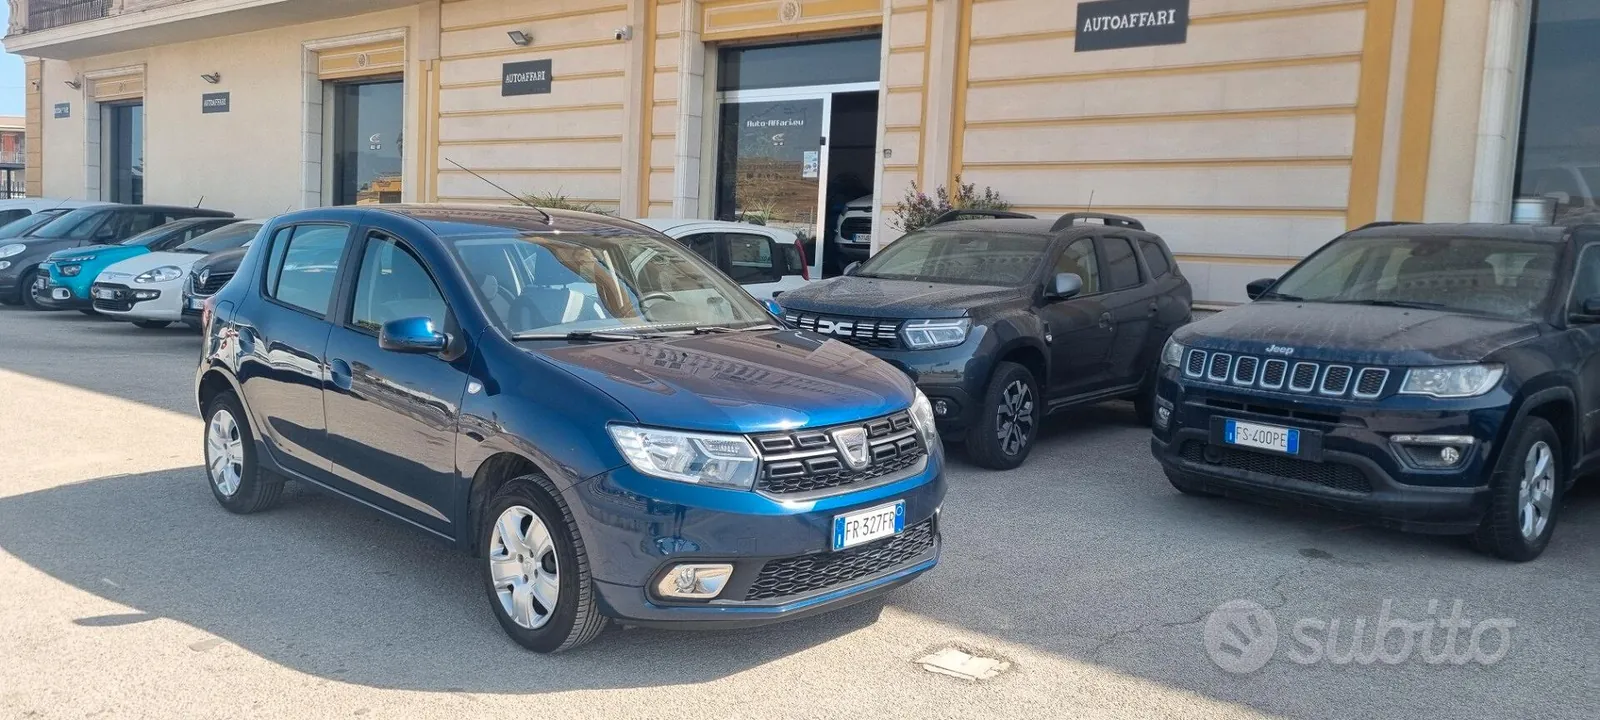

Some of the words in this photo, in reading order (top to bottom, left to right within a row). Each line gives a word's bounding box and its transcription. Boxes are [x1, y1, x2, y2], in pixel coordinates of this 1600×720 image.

[1083, 9, 1176, 32] AUTOAFFARI
[505, 70, 545, 83] AUTOAFFARI
[1265, 344, 1294, 355] Jeep
